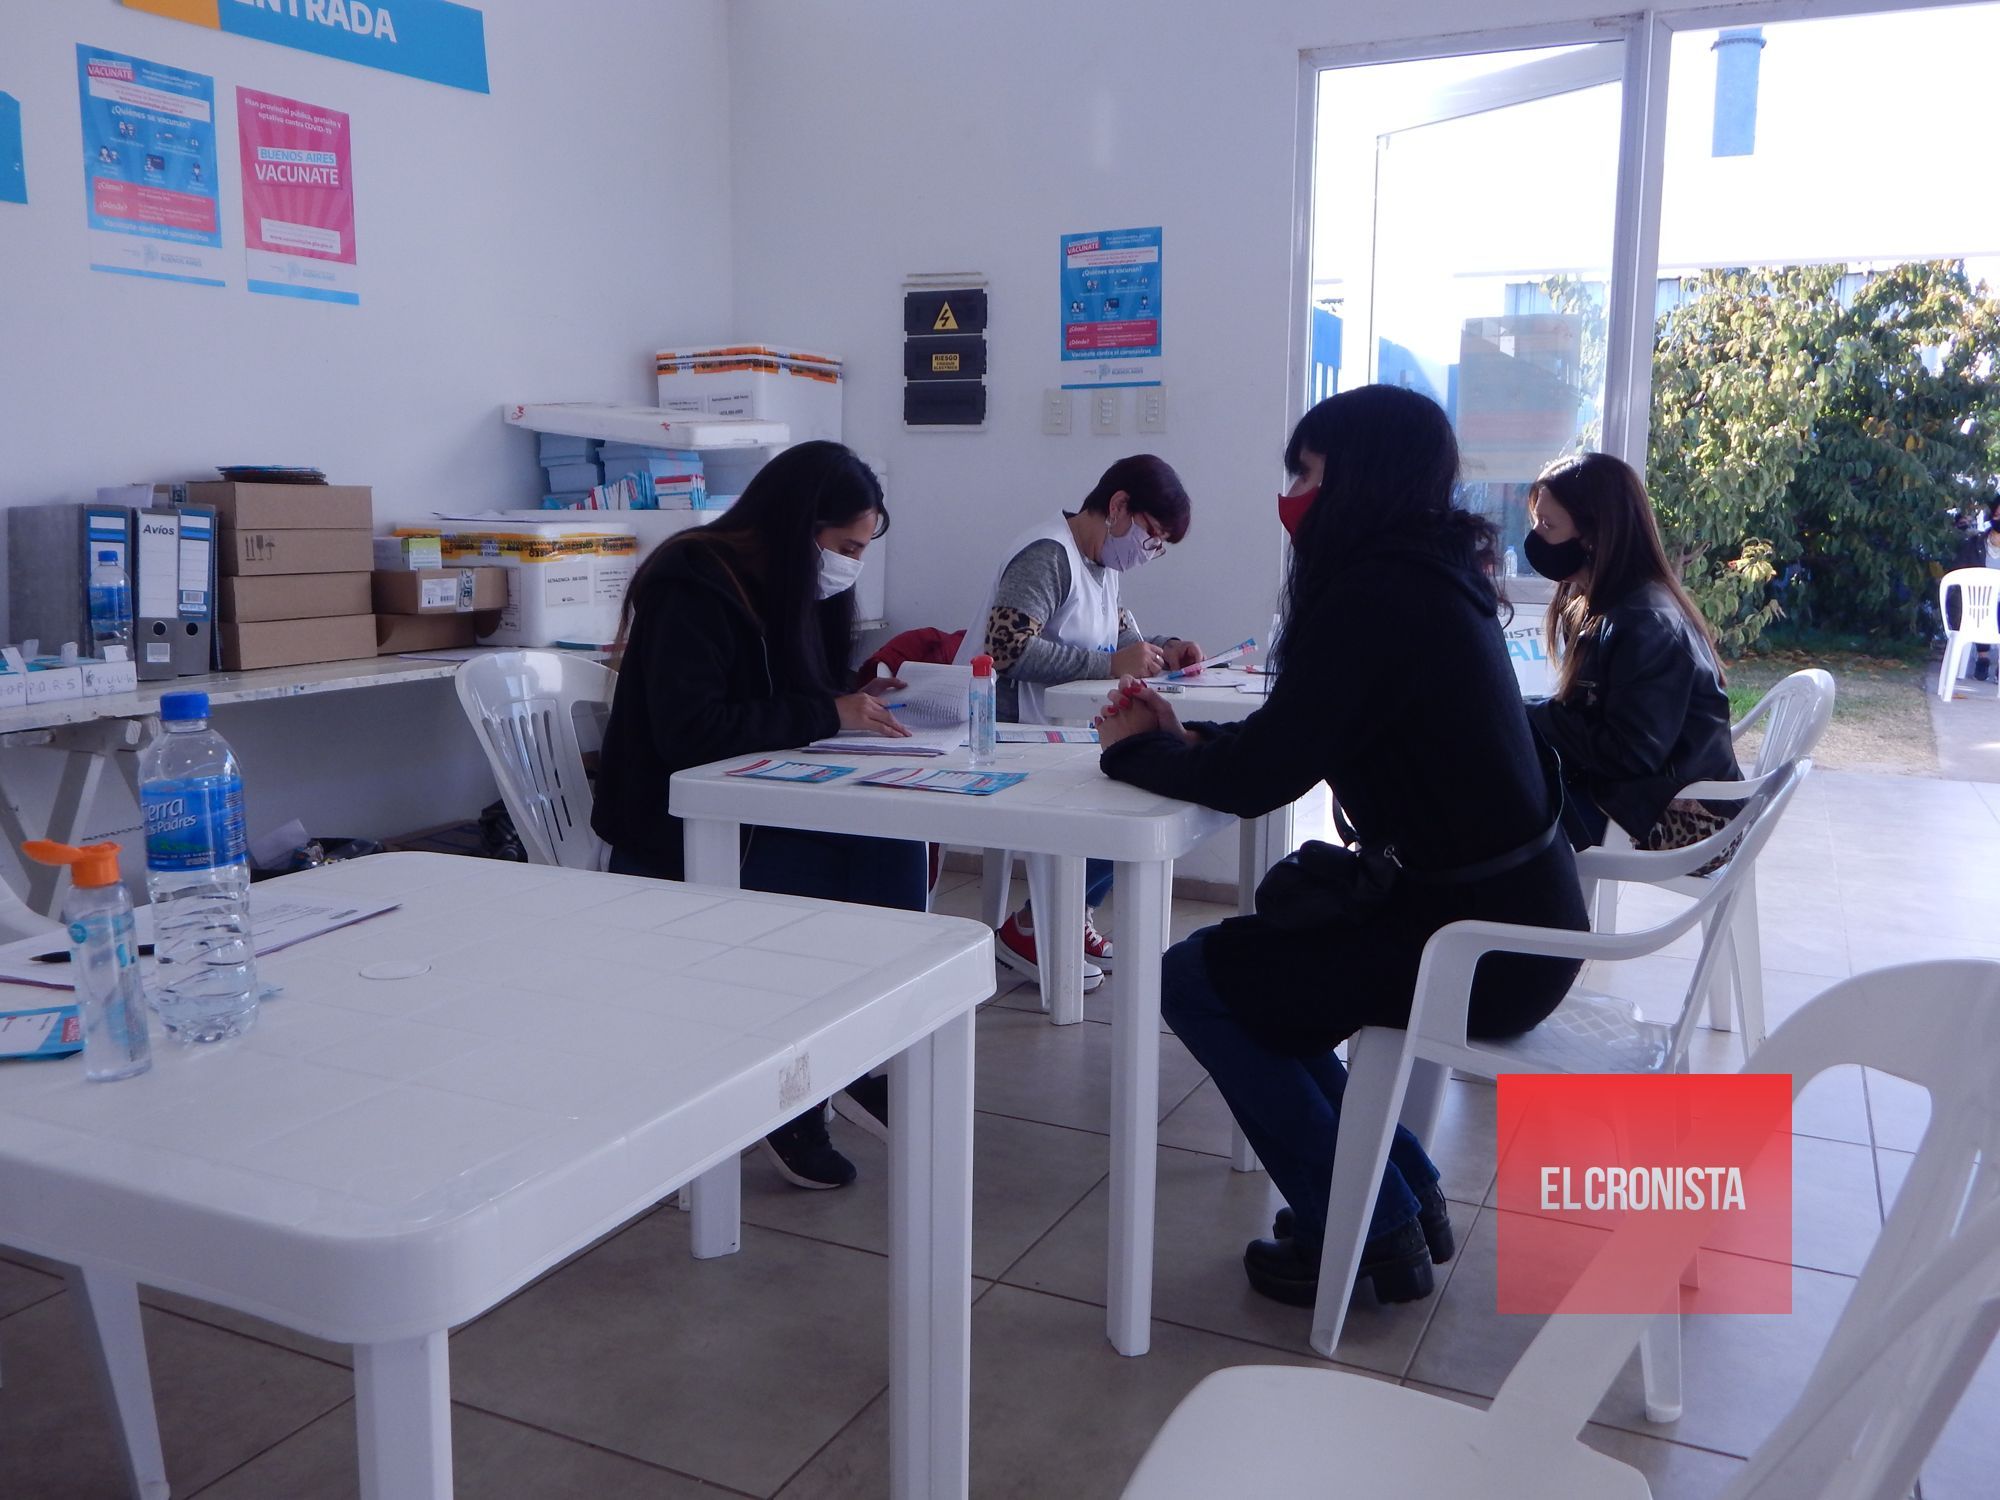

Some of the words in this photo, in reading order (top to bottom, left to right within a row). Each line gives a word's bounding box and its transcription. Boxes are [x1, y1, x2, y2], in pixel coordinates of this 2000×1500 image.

[233, 0, 397, 43] TRADA
[88, 65, 133, 80] VACUNATE
[260, 148, 304, 162] BUENOS
[306, 152, 335, 165] AIRES
[254, 163, 339, 185] VACUNATE
[1067, 243, 1099, 254] VACUNATE
[157, 815, 198, 834] Padres
